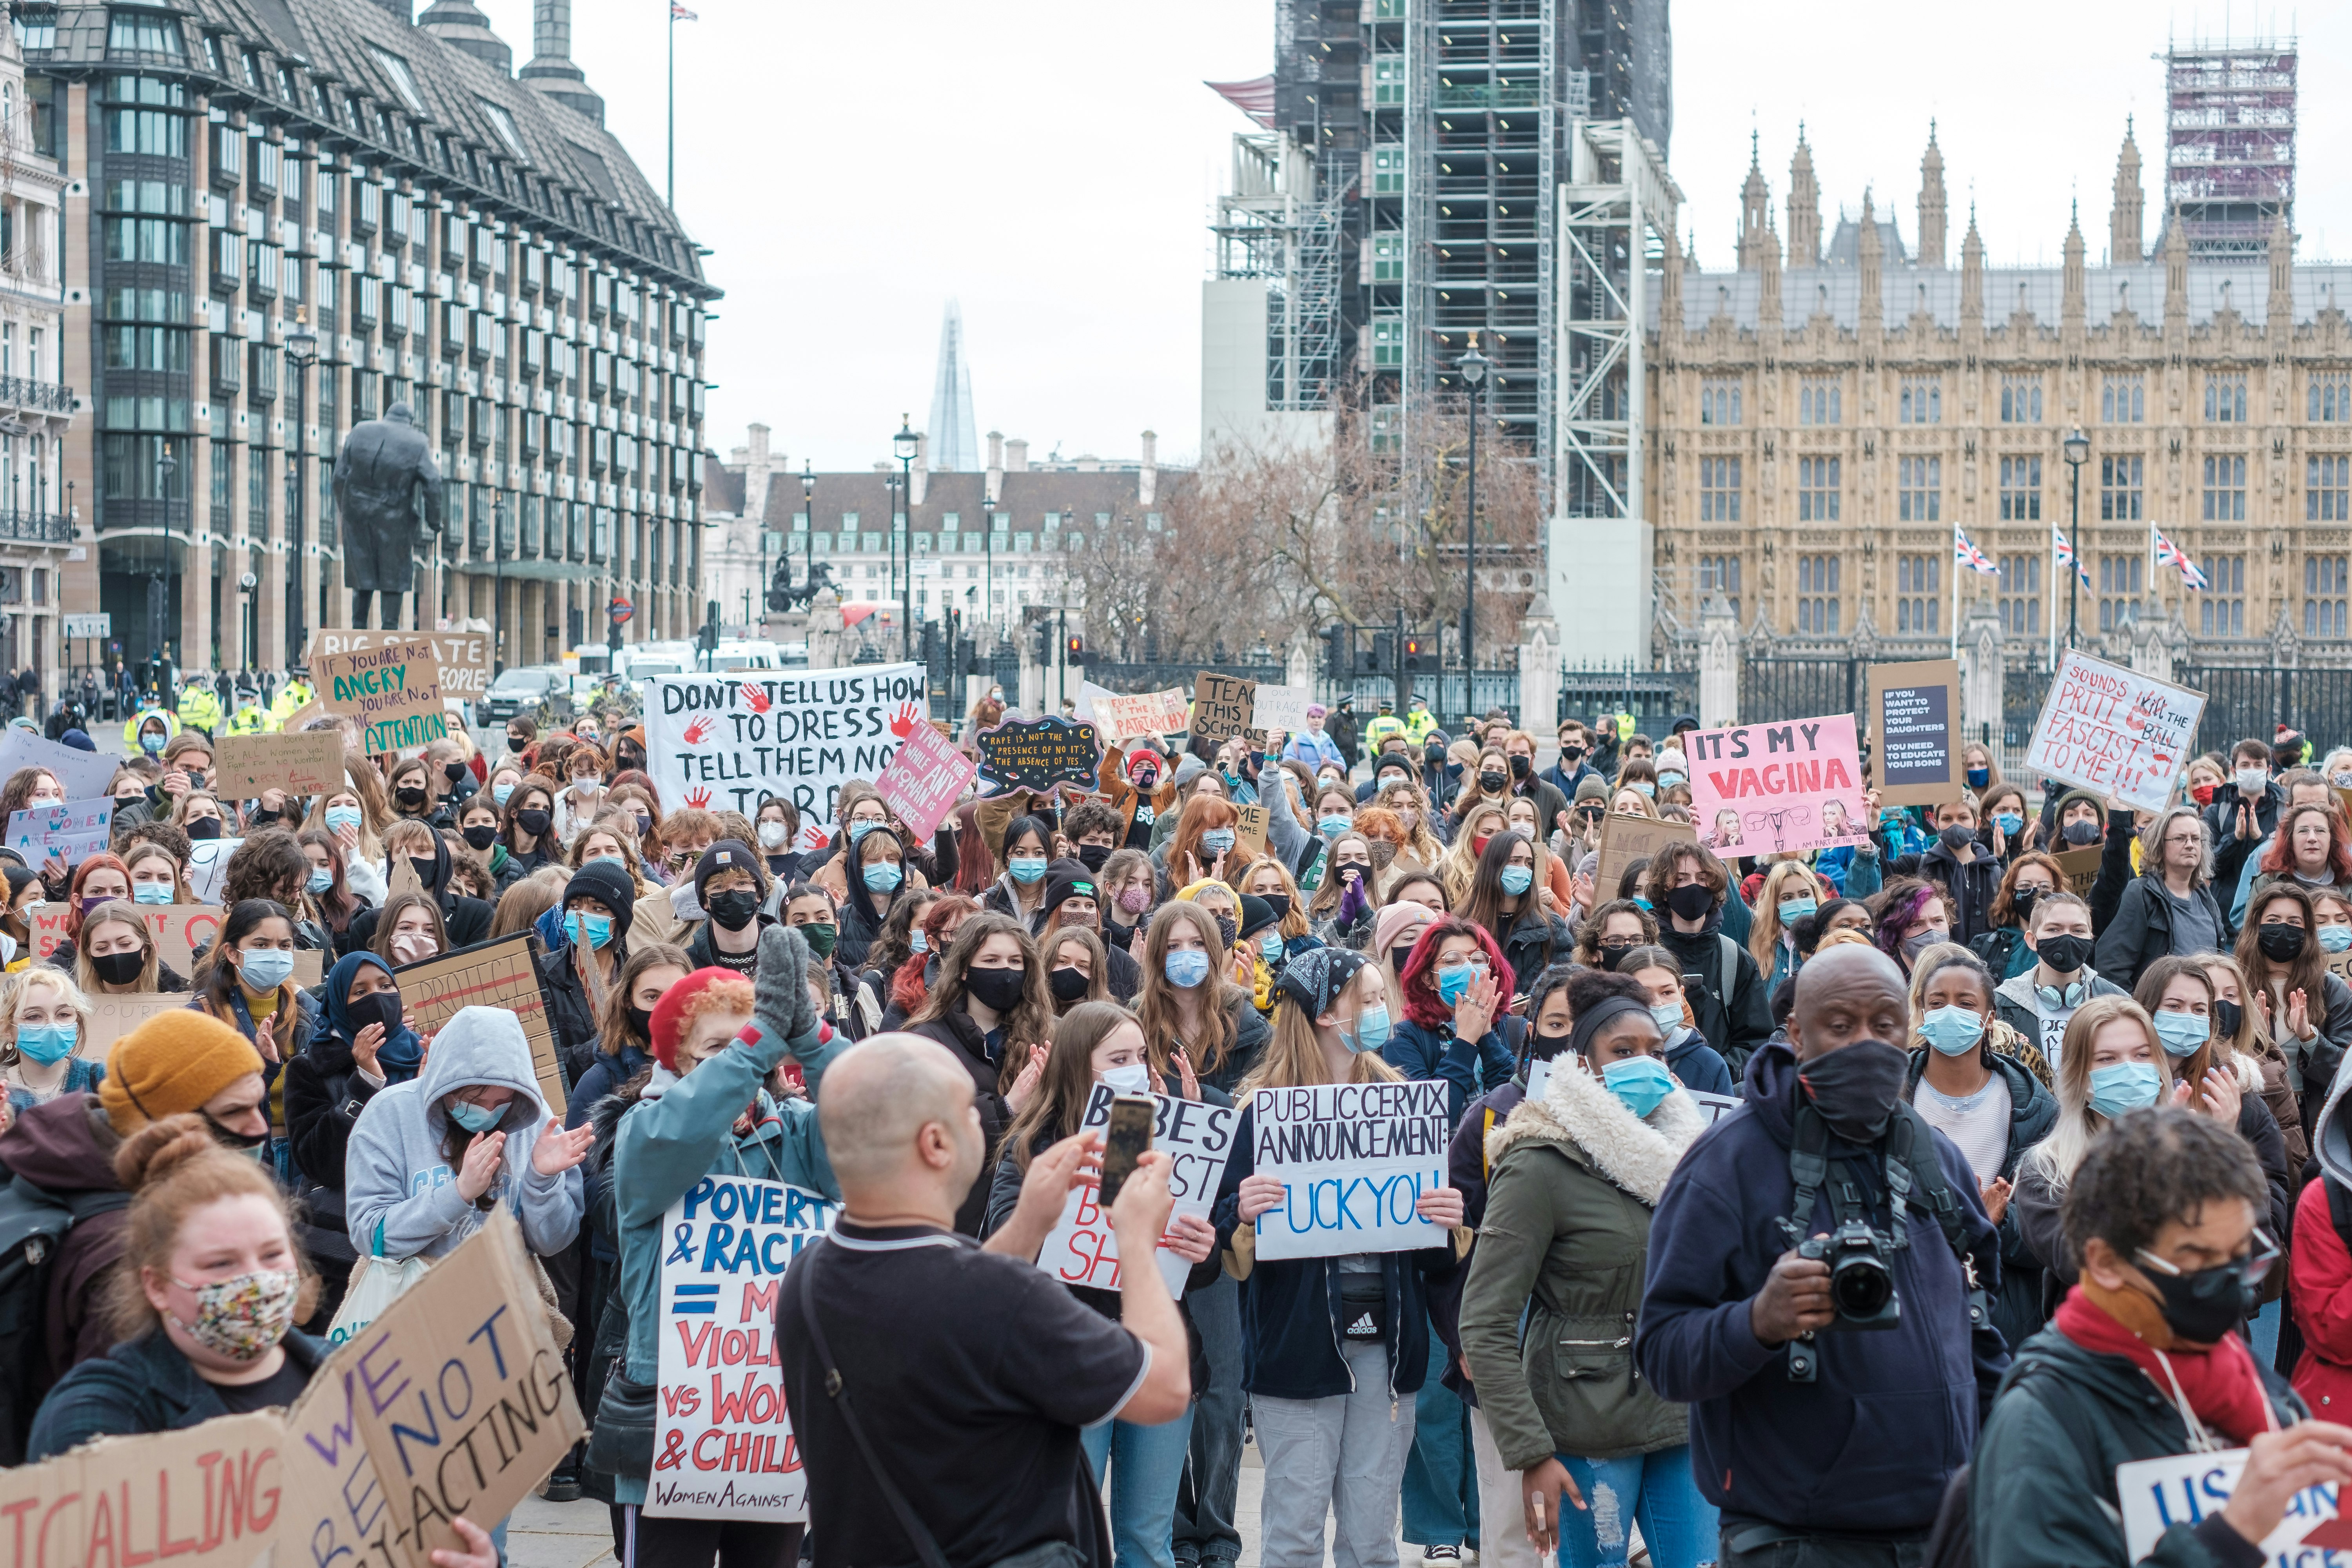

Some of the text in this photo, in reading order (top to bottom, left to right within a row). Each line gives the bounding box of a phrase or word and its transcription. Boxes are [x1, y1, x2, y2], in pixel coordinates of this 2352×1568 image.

[322, 658, 336, 677] IF
[348, 655, 377, 672] YOU
[379, 647, 400, 666] ARE
[334, 664, 406, 701] ANGRY
[2069, 666, 2129, 697] SOUNDS
[359, 697, 383, 711] YOU
[384, 690, 406, 706] ARE
[663, 675, 925, 714] DON'T TELL US HOW
[1111, 697, 1138, 708] FUCK
[1885, 699, 1914, 707] WANT
[1895, 690, 1915, 698] YOU
[2058, 681, 2122, 726] PRITI
[1128, 705, 1149, 715] THE
[1201, 701, 1241, 722] THIS
[1255, 699, 1302, 713] OUTRAGE
[1886, 707, 1930, 717] PROTECT
[728, 706, 883, 743] TO DRESS
[1116, 709, 1187, 736] PATRIARCHY
[1195, 716, 1268, 744] SCHOOLS
[1256, 714, 1300, 728] IS REAL
[1886, 717, 1912, 725] YOUR
[1886, 723, 1945, 734] DAUGHTERS
[2168, 712, 2189, 728] THE
[221, 739, 237, 749] IF
[312, 733, 333, 744] Fight
[365, 711, 447, 754] ATTENTION
[990, 736, 1011, 745] RAPE
[1028, 732, 1045, 742] NOT
[1048, 732, 1062, 742] THE
[1695, 724, 1820, 760] IT'S MY
[2047, 709, 2145, 764] FASCIST
[2141, 723, 2178, 750] BILL
[243, 750, 260, 759] ALL
[922, 731, 941, 752] AM
[936, 742, 956, 764] NOT
[949, 759, 969, 780] FREE
[998, 744, 1086, 755] PRESENCE OF NO IT'S
[1886, 742, 1934, 751] YOU NEED
[1901, 750, 1945, 759] EDUCATE
[2043, 740, 2070, 769] TO
[675, 752, 751, 782] TELL
[753, 745, 845, 777] THEM
[903, 742, 931, 771] WHILE
[921, 763, 958, 801] ANY
[994, 757, 1011, 766] THE
[1018, 757, 1049, 767] ABSENCE
[1054, 757, 1062, 765] OF
[1887, 759, 1942, 769] YOUR SONS
[289, 768, 317, 783] ALL
[886, 758, 937, 812] WOMAN IS
[1708, 759, 1852, 799] VAGINA
[17, 808, 68, 822] TRANS
[49, 812, 107, 831] WOMEN
[20, 831, 55, 848] ARE
[47, 839, 107, 857] WOMEN
[1613, 833, 1655, 858] NOT
[1815, 838, 1831, 847] PART
[2069, 870, 2098, 886] THE
[1257, 1082, 1448, 1123] PUBLIC CERVIX
[1085, 1085, 1231, 1151] BBES
[1256, 1114, 1448, 1165] ANNOUNCEMENT:
[1257, 1170, 1439, 1235] FUCK YOU
[666, 1223, 698, 1267] &
[1347, 1326, 1377, 1334] adidas
[305, 1330, 412, 1468] WE
[392, 1303, 508, 1477] NOT
[655, 1428, 687, 1472] &
